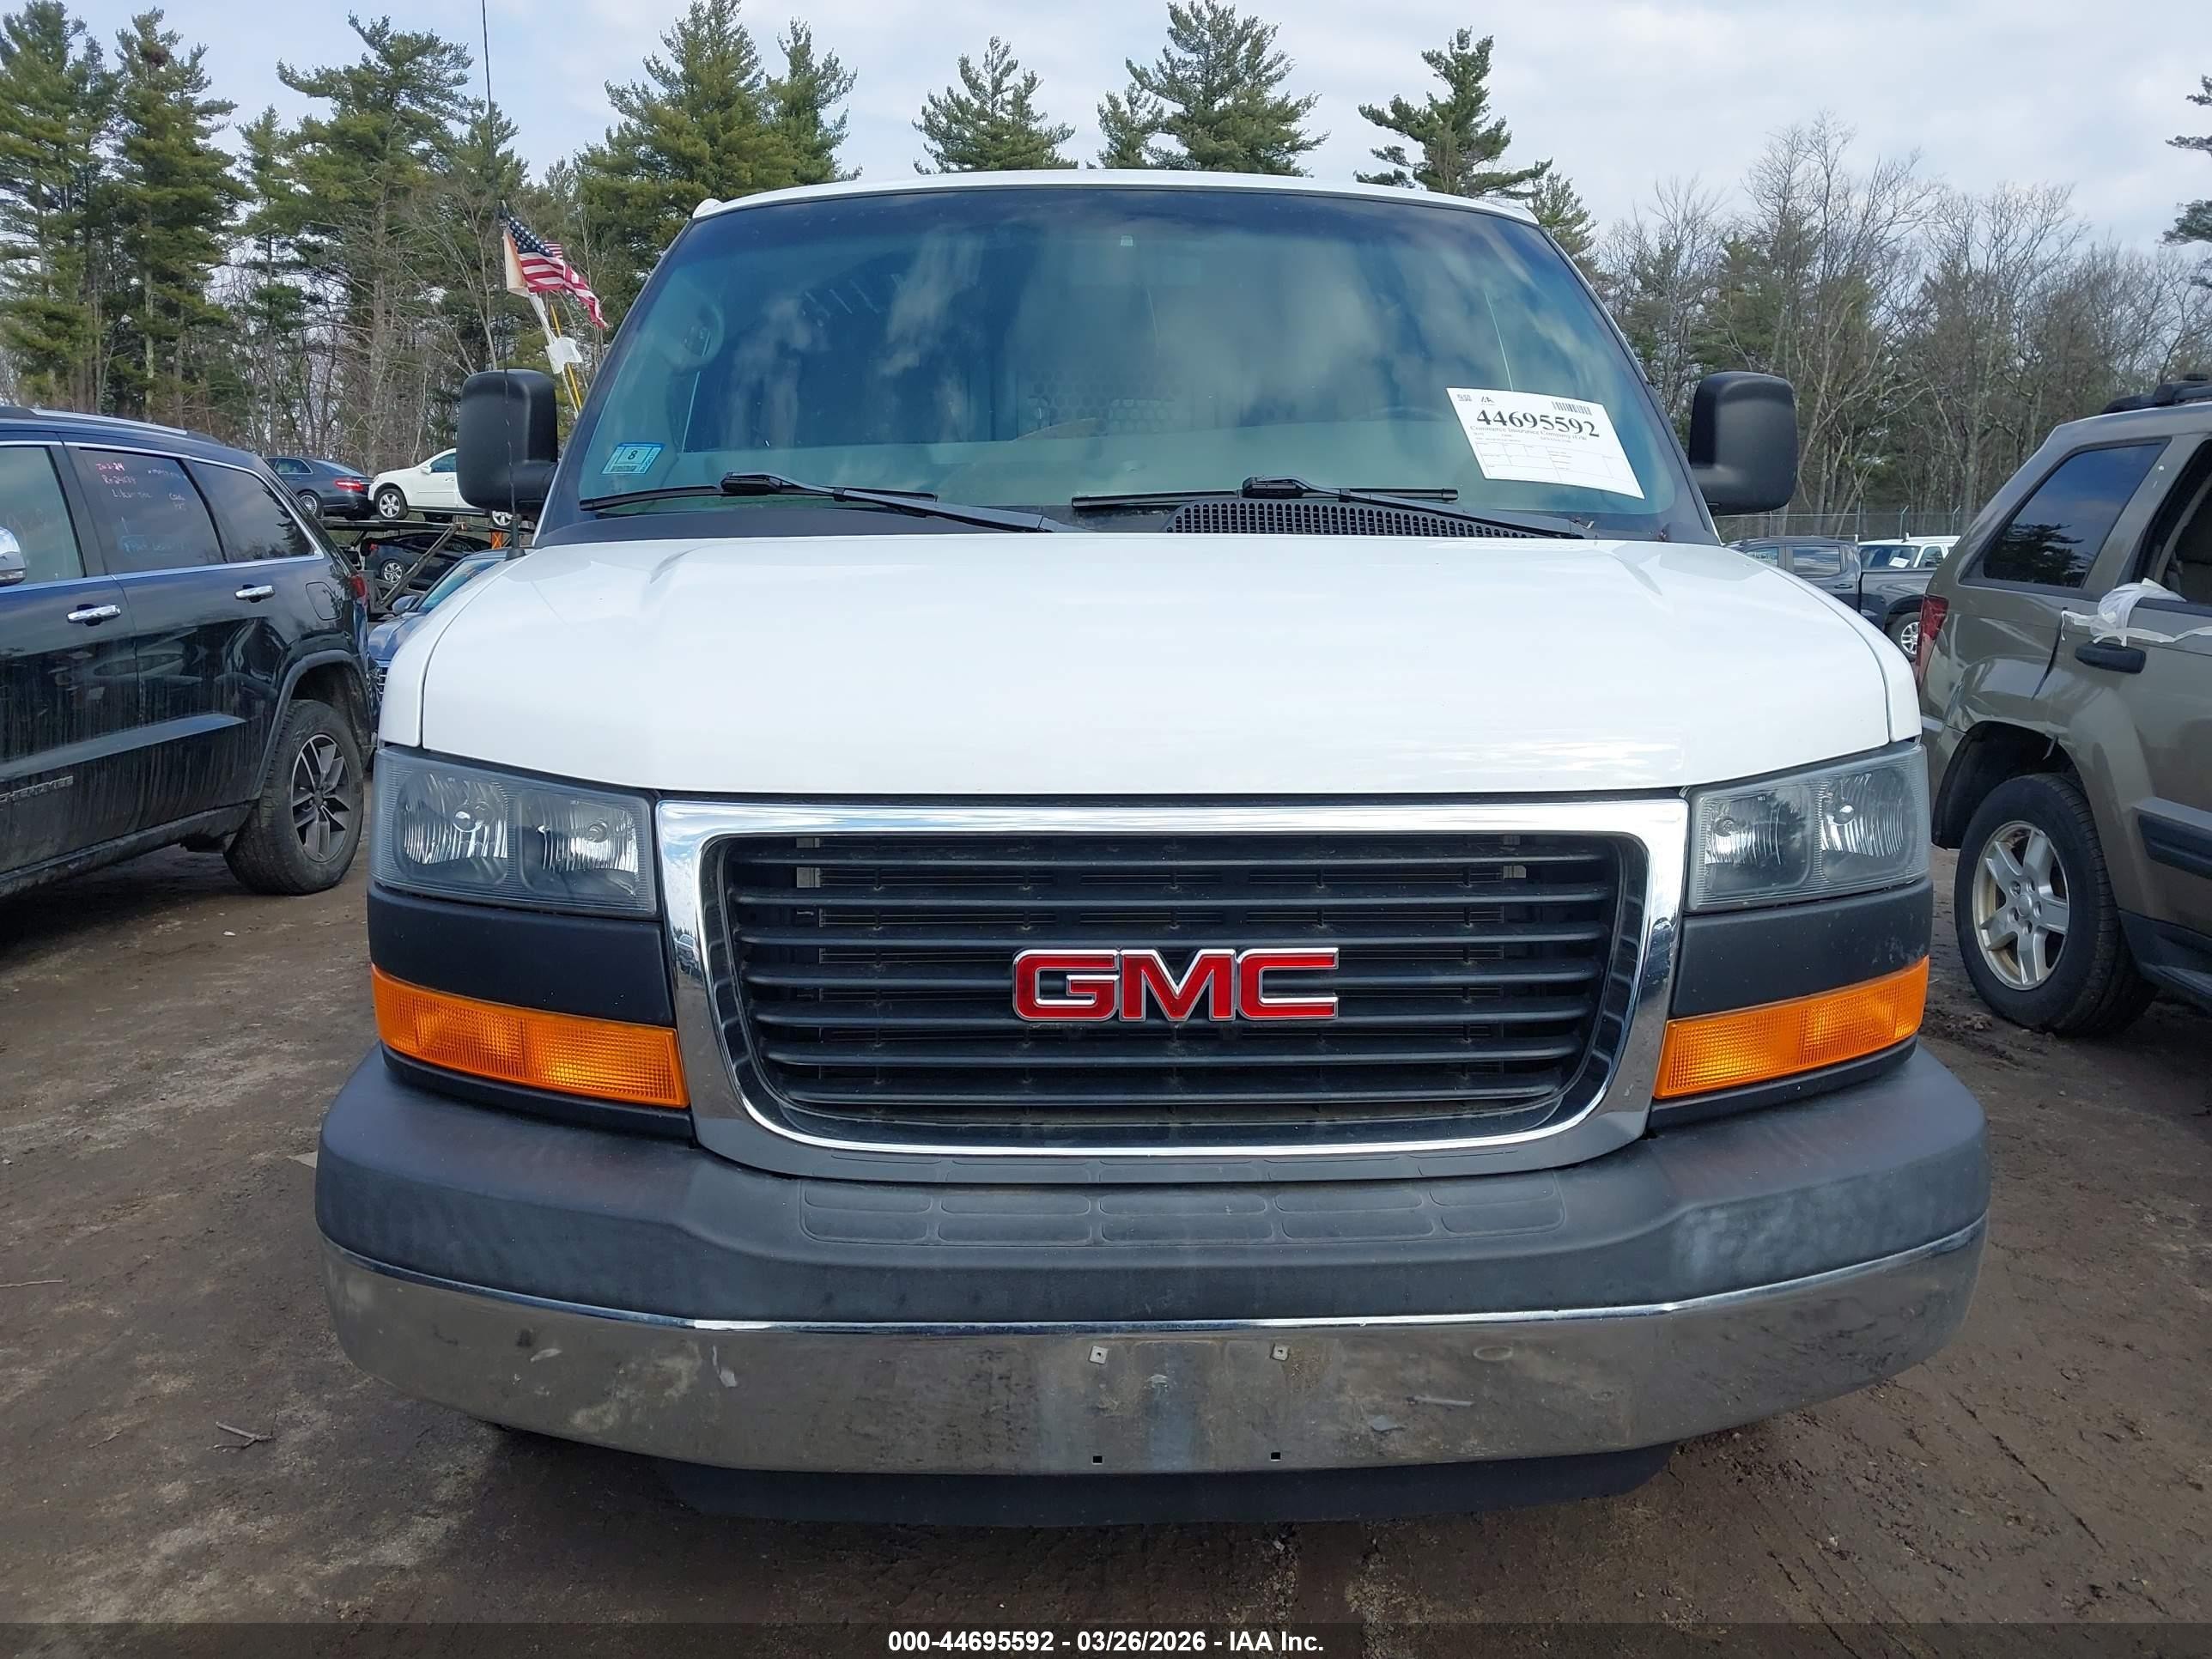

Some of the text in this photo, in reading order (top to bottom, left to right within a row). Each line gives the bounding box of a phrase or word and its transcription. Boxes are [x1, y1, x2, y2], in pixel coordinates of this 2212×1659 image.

[1476, 409, 1600, 437] 44695592
[628, 450, 638, 459] 8
[1012, 947, 1340, 1022] GMC
